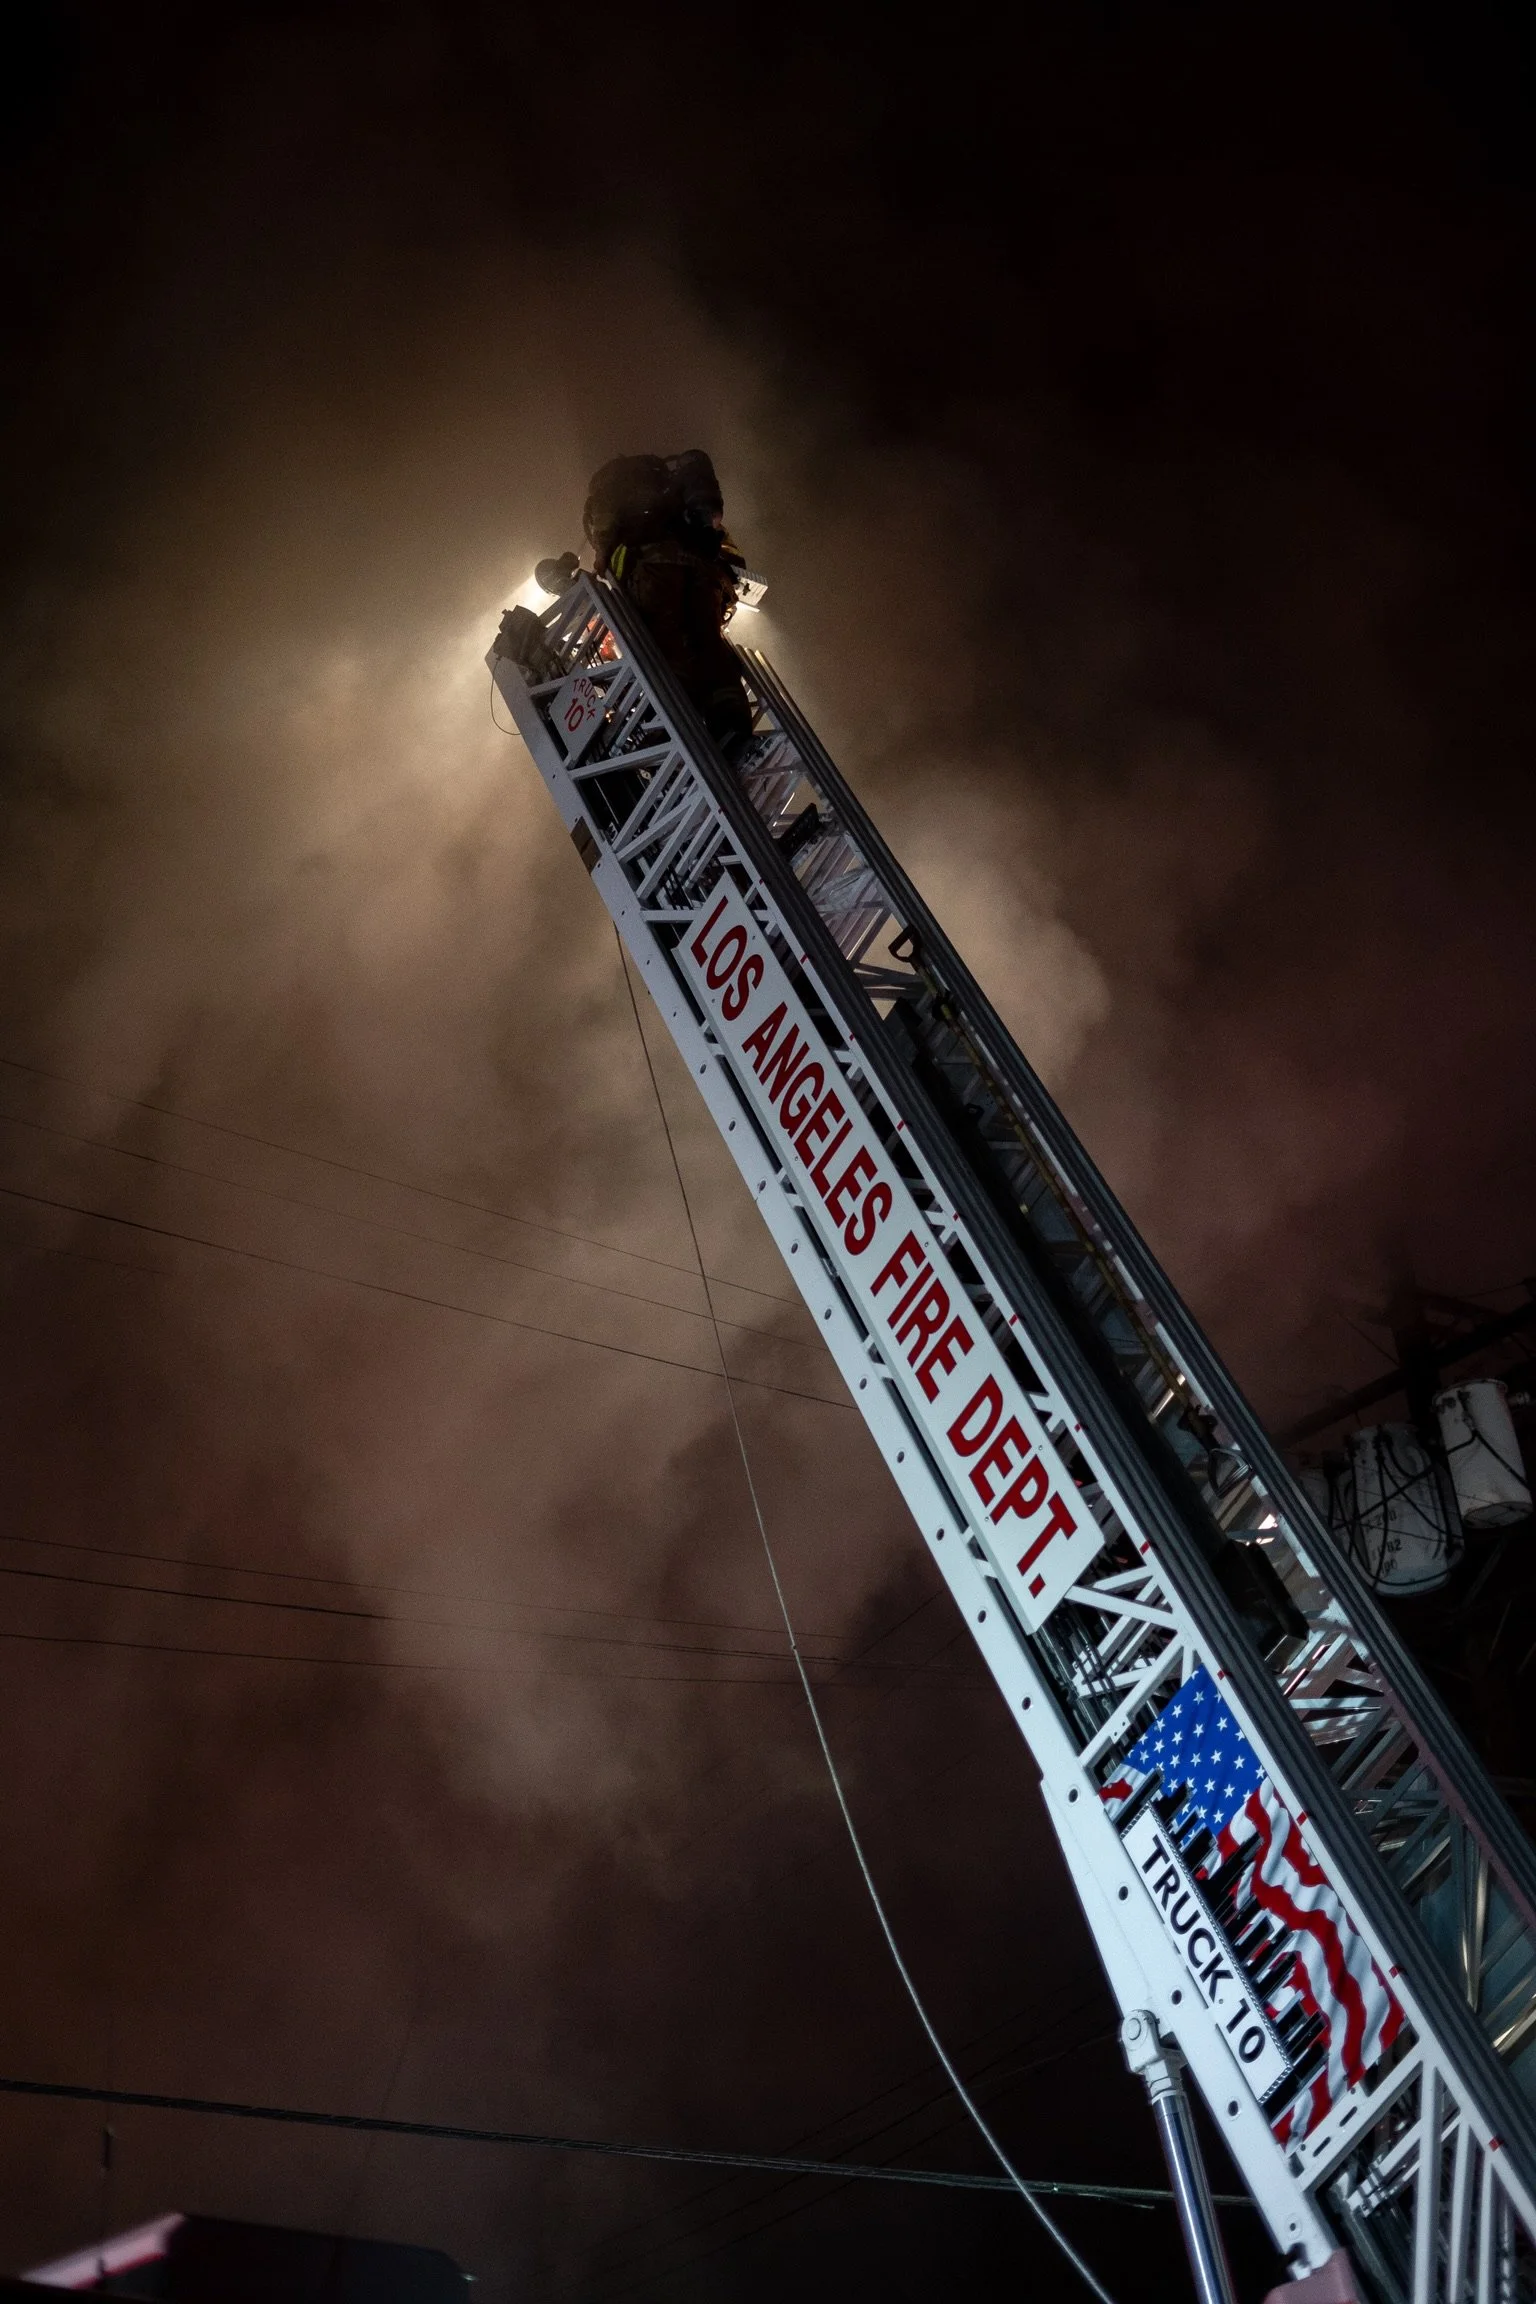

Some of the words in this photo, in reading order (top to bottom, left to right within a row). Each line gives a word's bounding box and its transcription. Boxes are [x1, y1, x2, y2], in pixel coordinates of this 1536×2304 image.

[564, 698, 585, 732] 10
[573, 678, 596, 720] TRUCK
[690, 896, 763, 1021] LOS
[742, 1002, 893, 1255] ANGELES
[871, 1230, 975, 1403] FIRE
[947, 1374, 1078, 1599] DEPT.
[1142, 1834, 1234, 2001] TRUCK
[1226, 1998, 1265, 2063] 10
